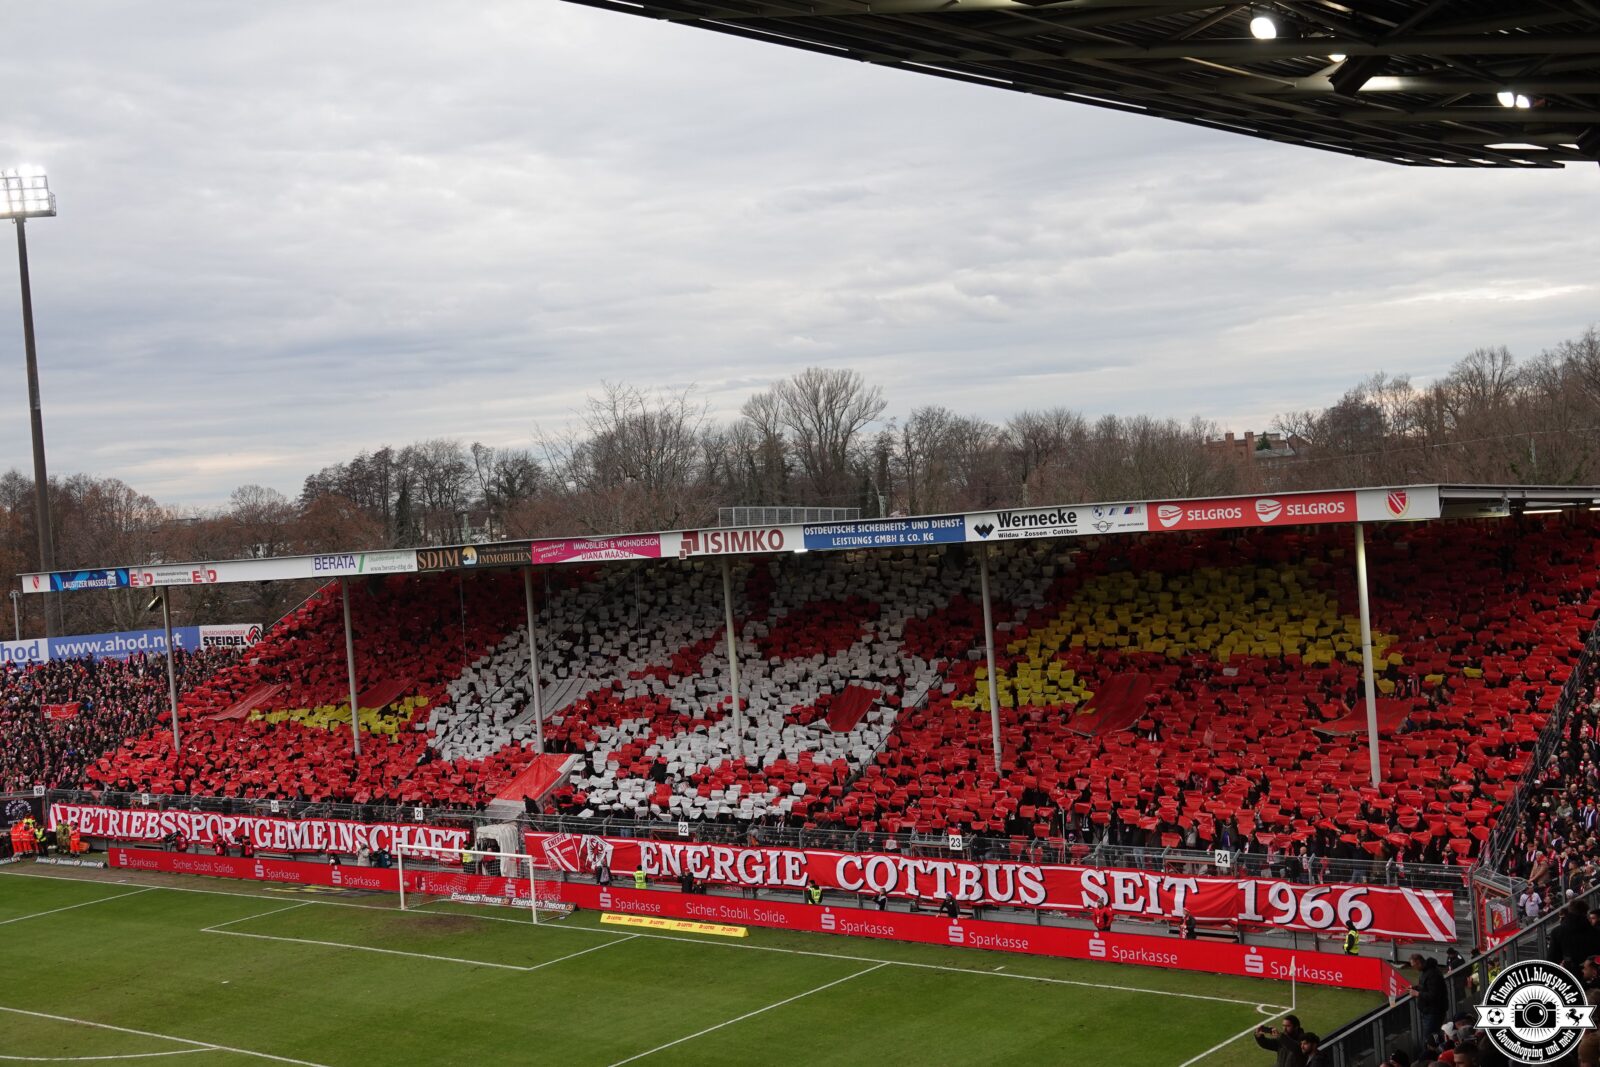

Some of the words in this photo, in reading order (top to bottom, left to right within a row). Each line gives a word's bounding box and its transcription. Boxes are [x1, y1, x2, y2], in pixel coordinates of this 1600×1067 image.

[1187, 507, 1242, 521] SELGROS
[1287, 502, 1345, 516] SELGROS
[997, 508, 1077, 528] Wernecke
[804, 524, 856, 535] OSTDEUTSCHE
[857, 521, 909, 533] SICHERHEITS-
[911, 520, 929, 530] UND
[931, 518, 963, 529] DIENST-
[1052, 528, 1078, 536] Cottbus
[573, 541, 609, 550] IMMOBILIEN
[610, 540, 616, 549] &
[616, 538, 659, 548] WOHNDESIGN
[703, 529, 784, 553] ISIMKO
[832, 535, 873, 546] LEISTUNGS
[874, 534, 897, 545] GMBH
[899, 534, 906, 544] &
[908, 533, 921, 543] CO.
[923, 532, 934, 542] KG
[417, 549, 460, 569] SDIM
[479, 552, 532, 564] IMMOBILIEN
[581, 551, 603, 560] DIANA
[604, 549, 634, 559] MAASCH
[314, 554, 356, 571] BERATA
[62, 579, 88, 589] LAUSITZER
[88, 577, 108, 587] WASSER
[55, 632, 183, 656] www.ahod.net
[203, 635, 247, 646] STEIDEL
[415, 809, 422, 818] 21
[66, 805, 467, 859] BETRIEBSSPORTGEMEINSCHAFT
[679, 825, 687, 834] 22
[951, 838, 961, 848] 23
[129, 857, 159, 868] Sparkasse
[1216, 852, 1229, 865] 24
[266, 868, 300, 881] Sparkasse
[344, 875, 380, 888] Sparkasse
[429, 880, 467, 893] Sparkasse
[638, 841, 810, 887] ENERGIE
[836, 854, 1047, 905] COTTBUS
[1080, 869, 1198, 918] SEIT
[1237, 879, 1374, 931] 1966
[451, 892, 481, 902] Eisenbach
[511, 898, 542, 908] Eisenbch
[615, 900, 661, 913] Sparkasse
[686, 902, 718, 917] Sicher.
[720, 905, 751, 920] Stabil.
[753, 908, 789, 924] Solide.
[840, 919, 895, 936] Sparkasse
[969, 931, 1029, 950] Sparkasse
[1111, 945, 1178, 965] Sparkasse
